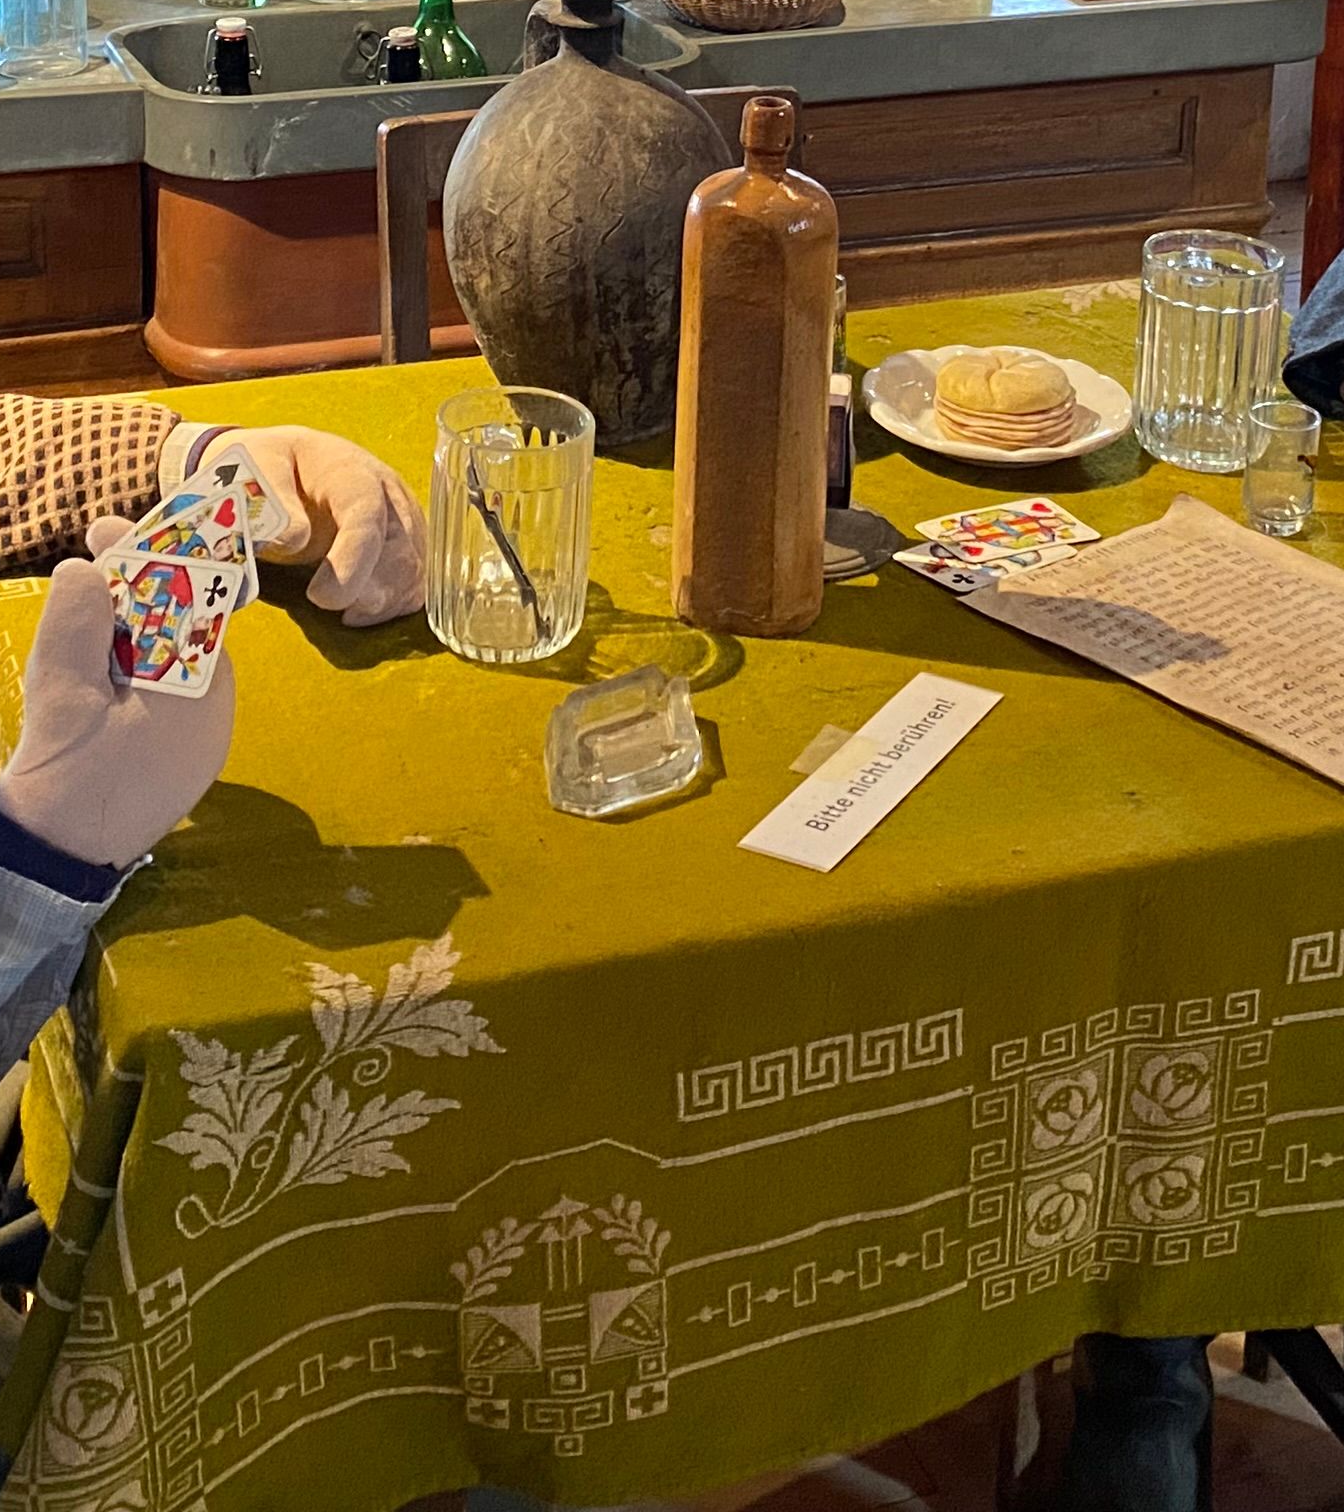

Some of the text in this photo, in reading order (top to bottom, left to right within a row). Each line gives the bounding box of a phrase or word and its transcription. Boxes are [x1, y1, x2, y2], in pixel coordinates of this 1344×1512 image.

[806, 697, 957, 832] Bitte nicht berühren!
